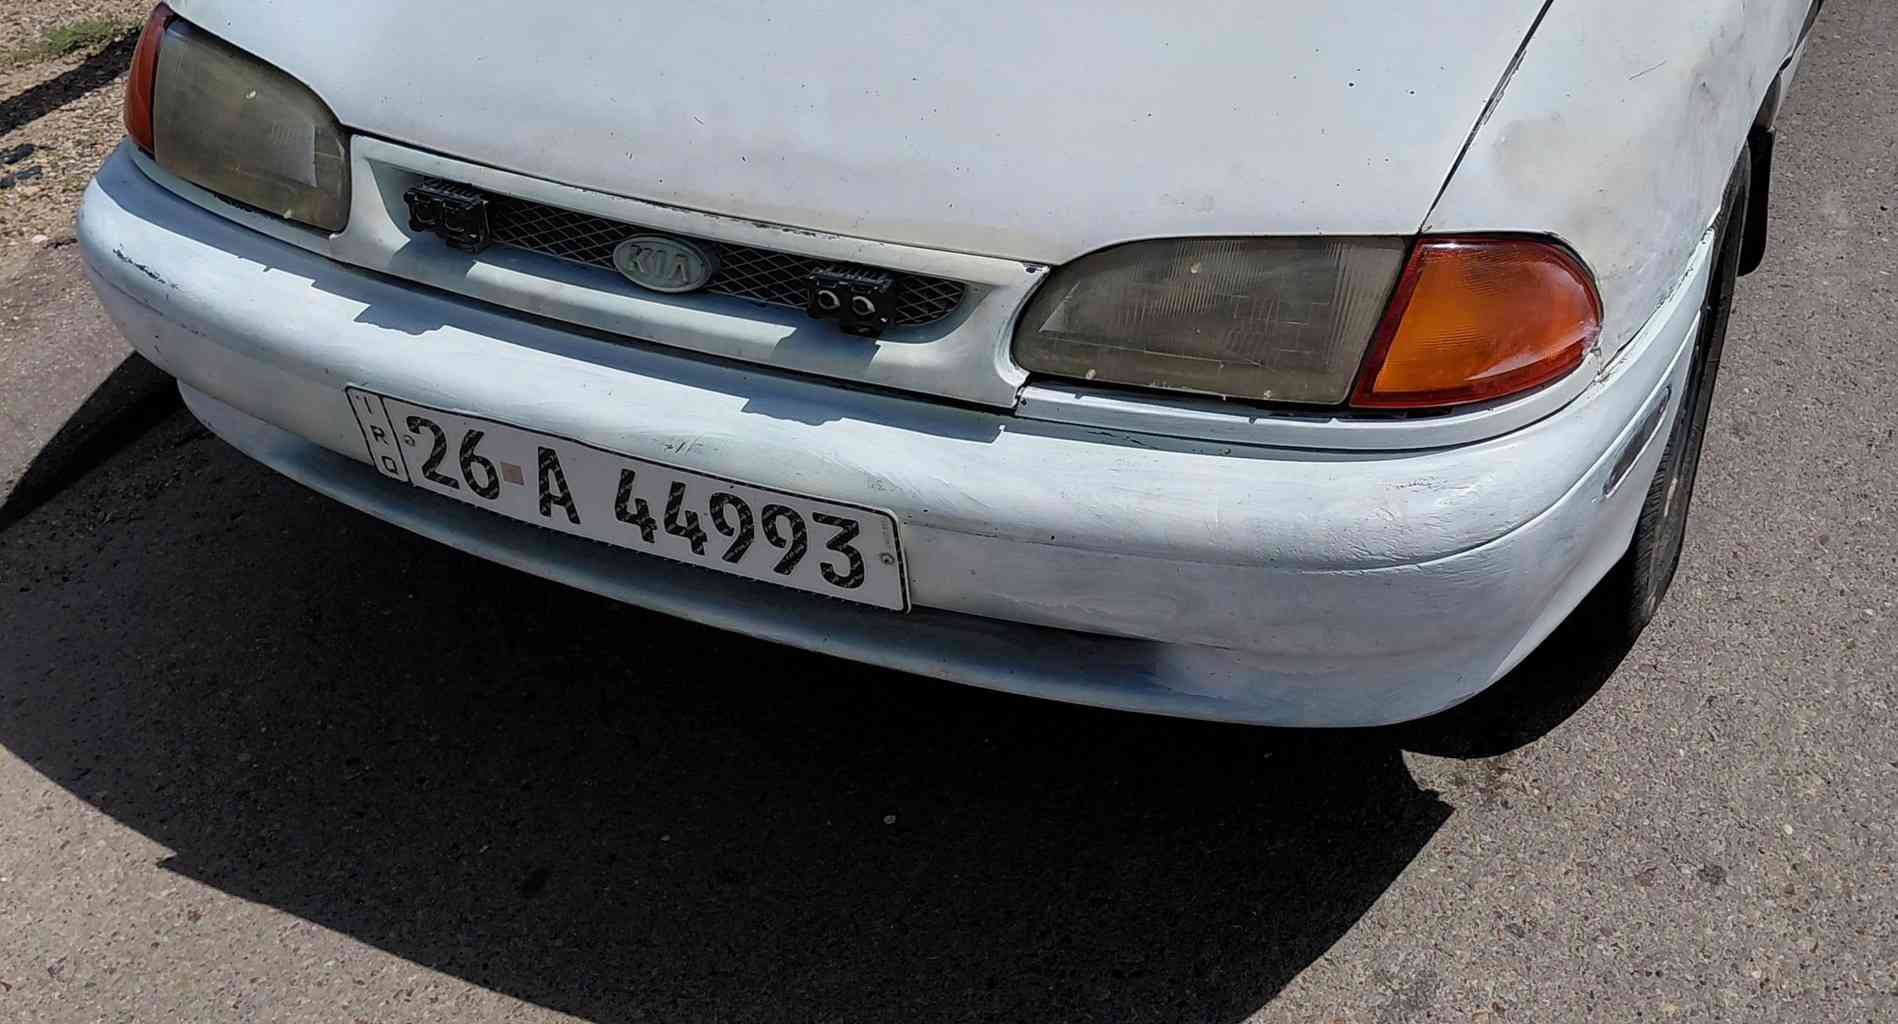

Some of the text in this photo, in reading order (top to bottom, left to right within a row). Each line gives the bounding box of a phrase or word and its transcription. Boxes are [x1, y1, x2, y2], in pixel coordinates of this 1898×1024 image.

[363, 396, 400, 475] IRQ
[405, 415, 866, 589] 26 A 44993
